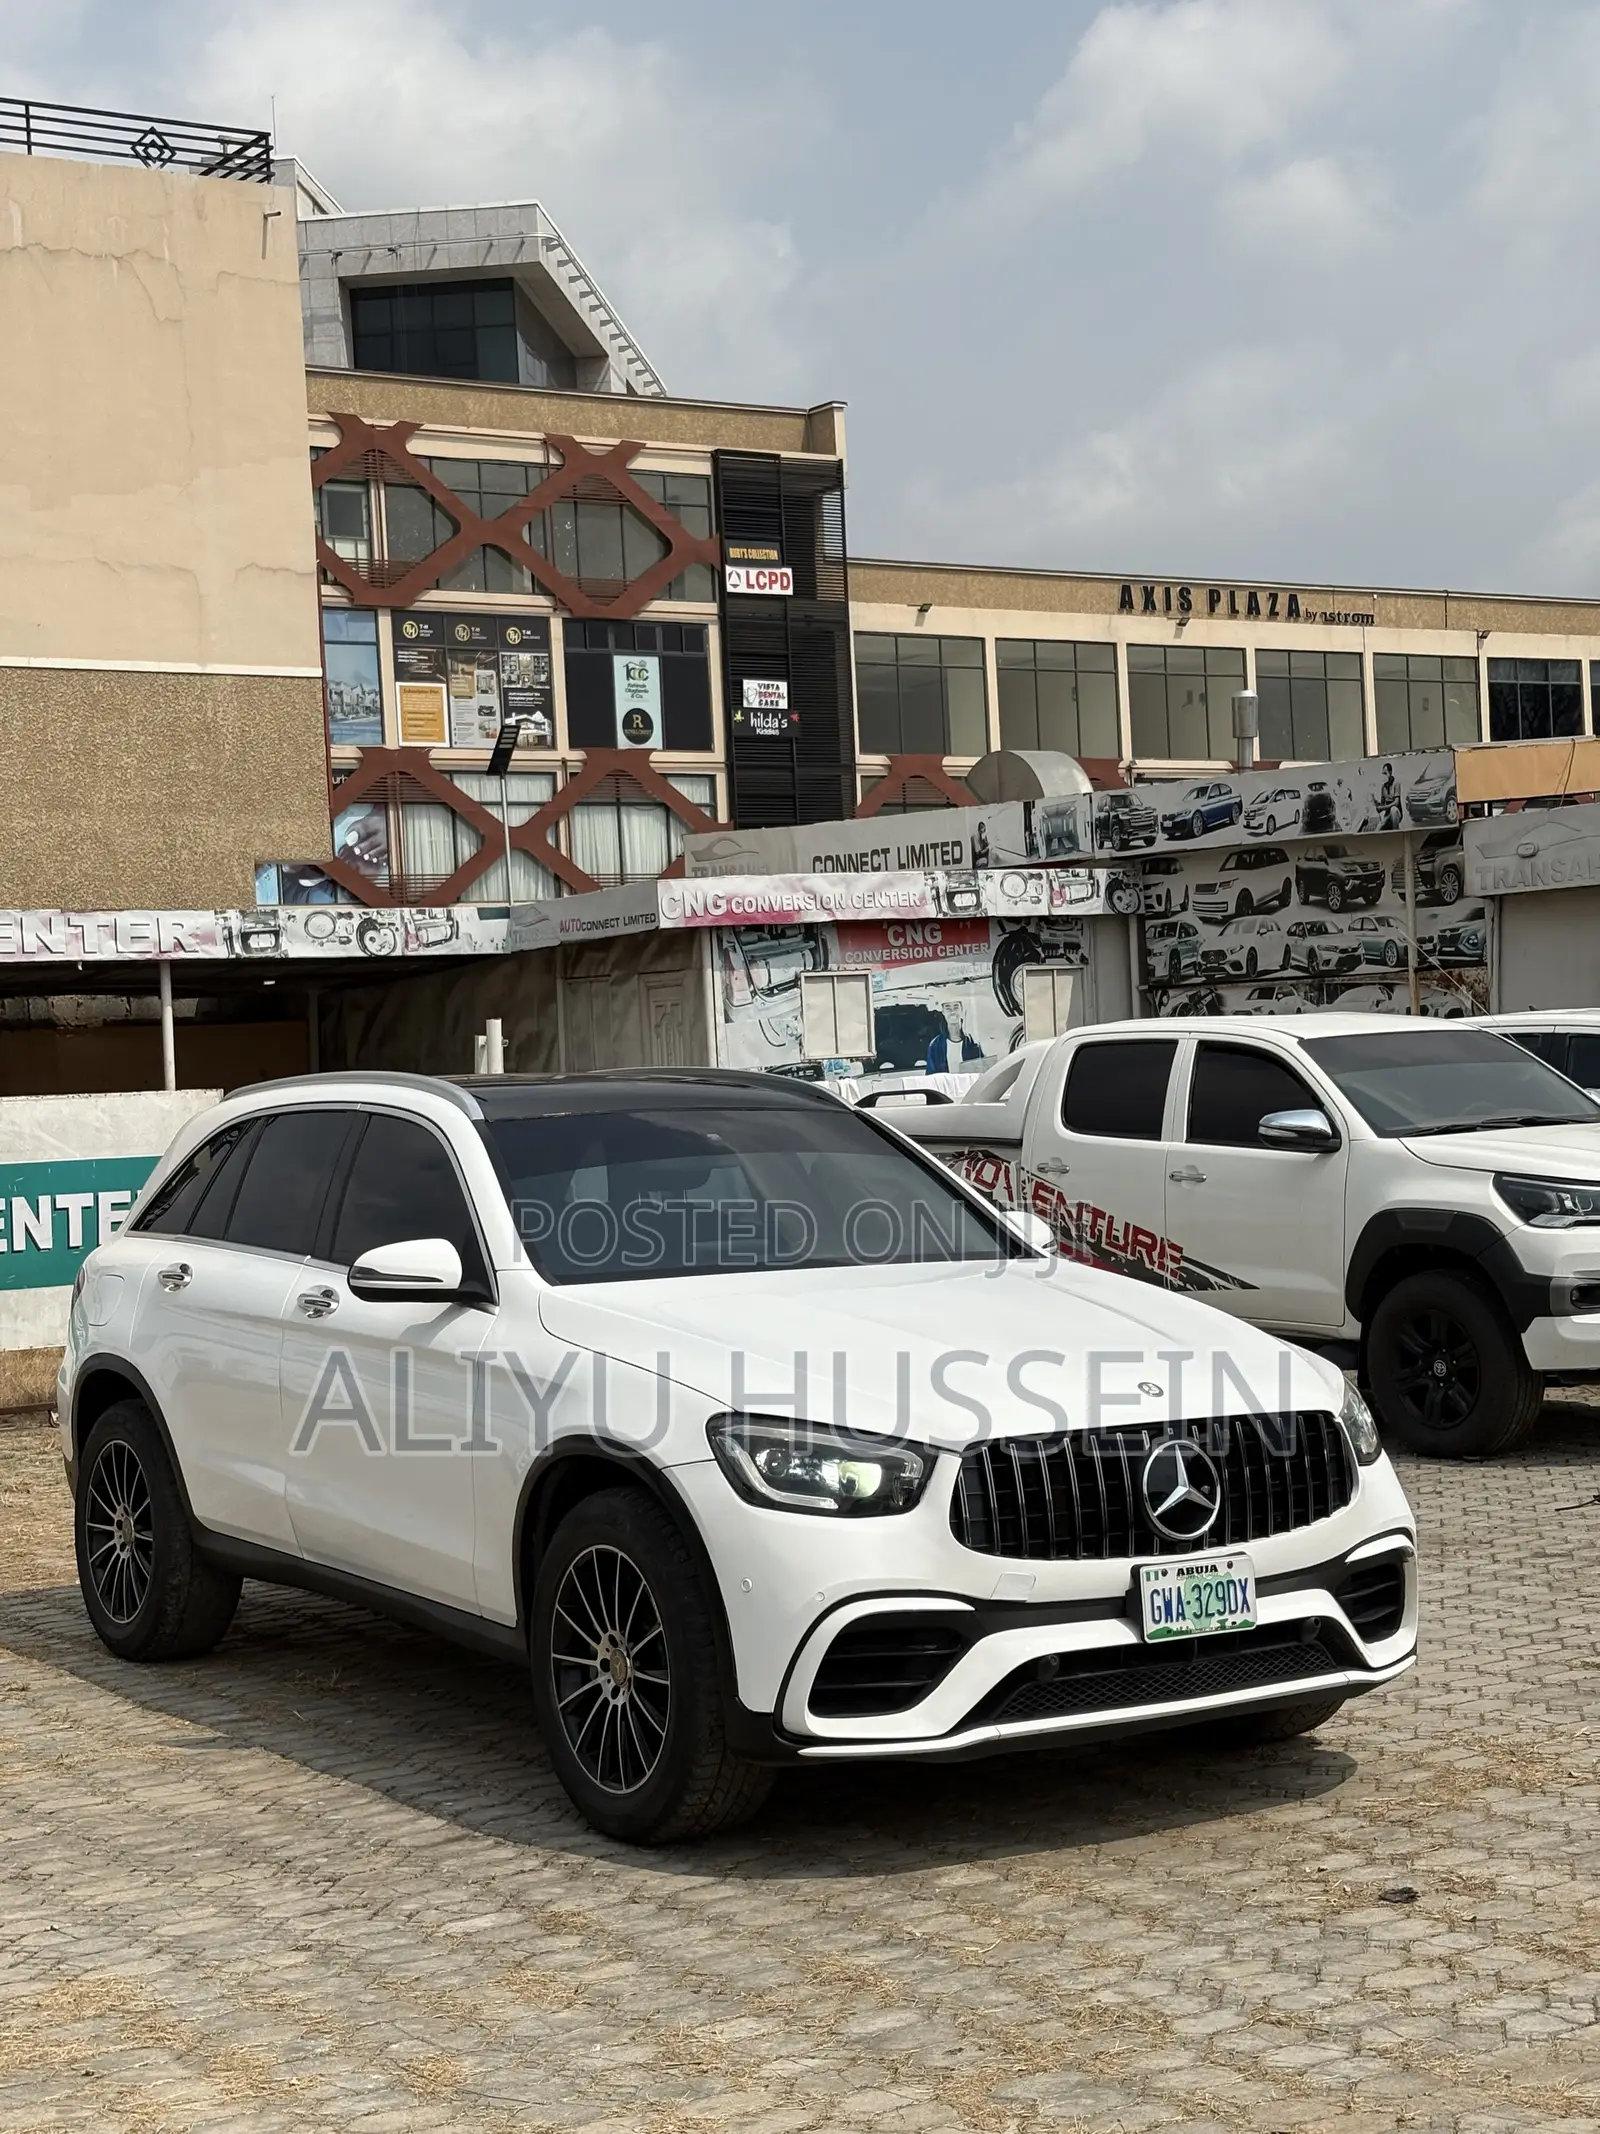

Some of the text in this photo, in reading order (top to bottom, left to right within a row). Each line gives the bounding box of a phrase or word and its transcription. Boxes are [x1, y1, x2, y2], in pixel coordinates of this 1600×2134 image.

[745, 570, 790, 591] LCPD
[1118, 584, 1193, 613] AXIS
[1207, 588, 1301, 618] PLAZA
[1304, 607, 1317, 622] by
[757, 683, 780, 691] VISTA
[758, 691, 786, 700] DENTAL
[758, 699, 780, 707] CARE
[632, 714, 644, 728] R
[750, 712, 788, 729] hilda's
[812, 840, 963, 874] CONNECT LIMITED
[660, 888, 921, 919] CNG CONVERSION CENTER
[559, 912, 657, 934] AUTOCONNECT LIMITED
[887, 922, 942, 947] CNG
[845, 942, 989, 964] CONVERSION CENTER
[1176, 1564, 1219, 1576] ABUJA
